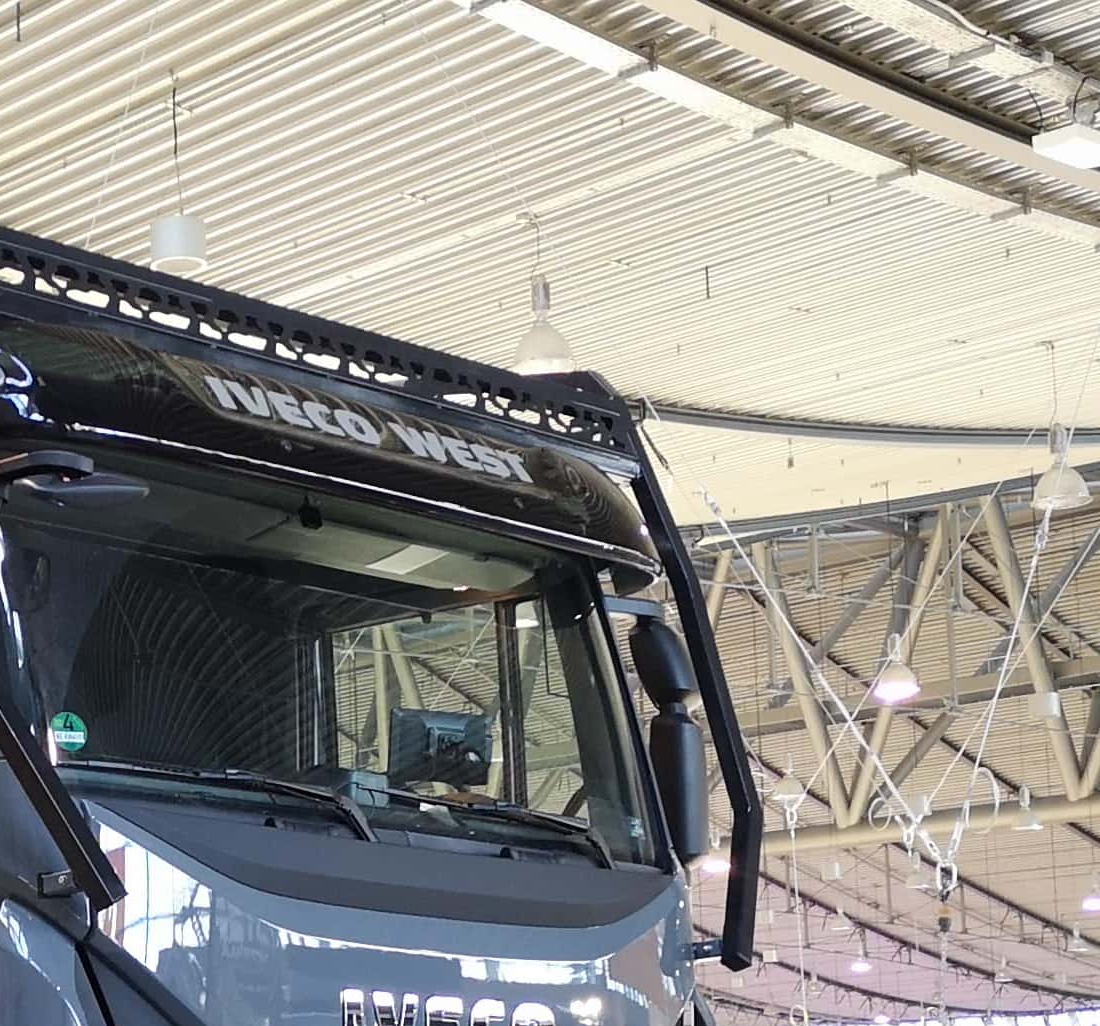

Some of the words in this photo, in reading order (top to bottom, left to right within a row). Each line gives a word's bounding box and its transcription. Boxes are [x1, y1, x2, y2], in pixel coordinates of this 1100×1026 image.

[204, 375, 381, 447] IVECO
[387, 421, 534, 483] WEST
[63, 714, 74, 731] 4
